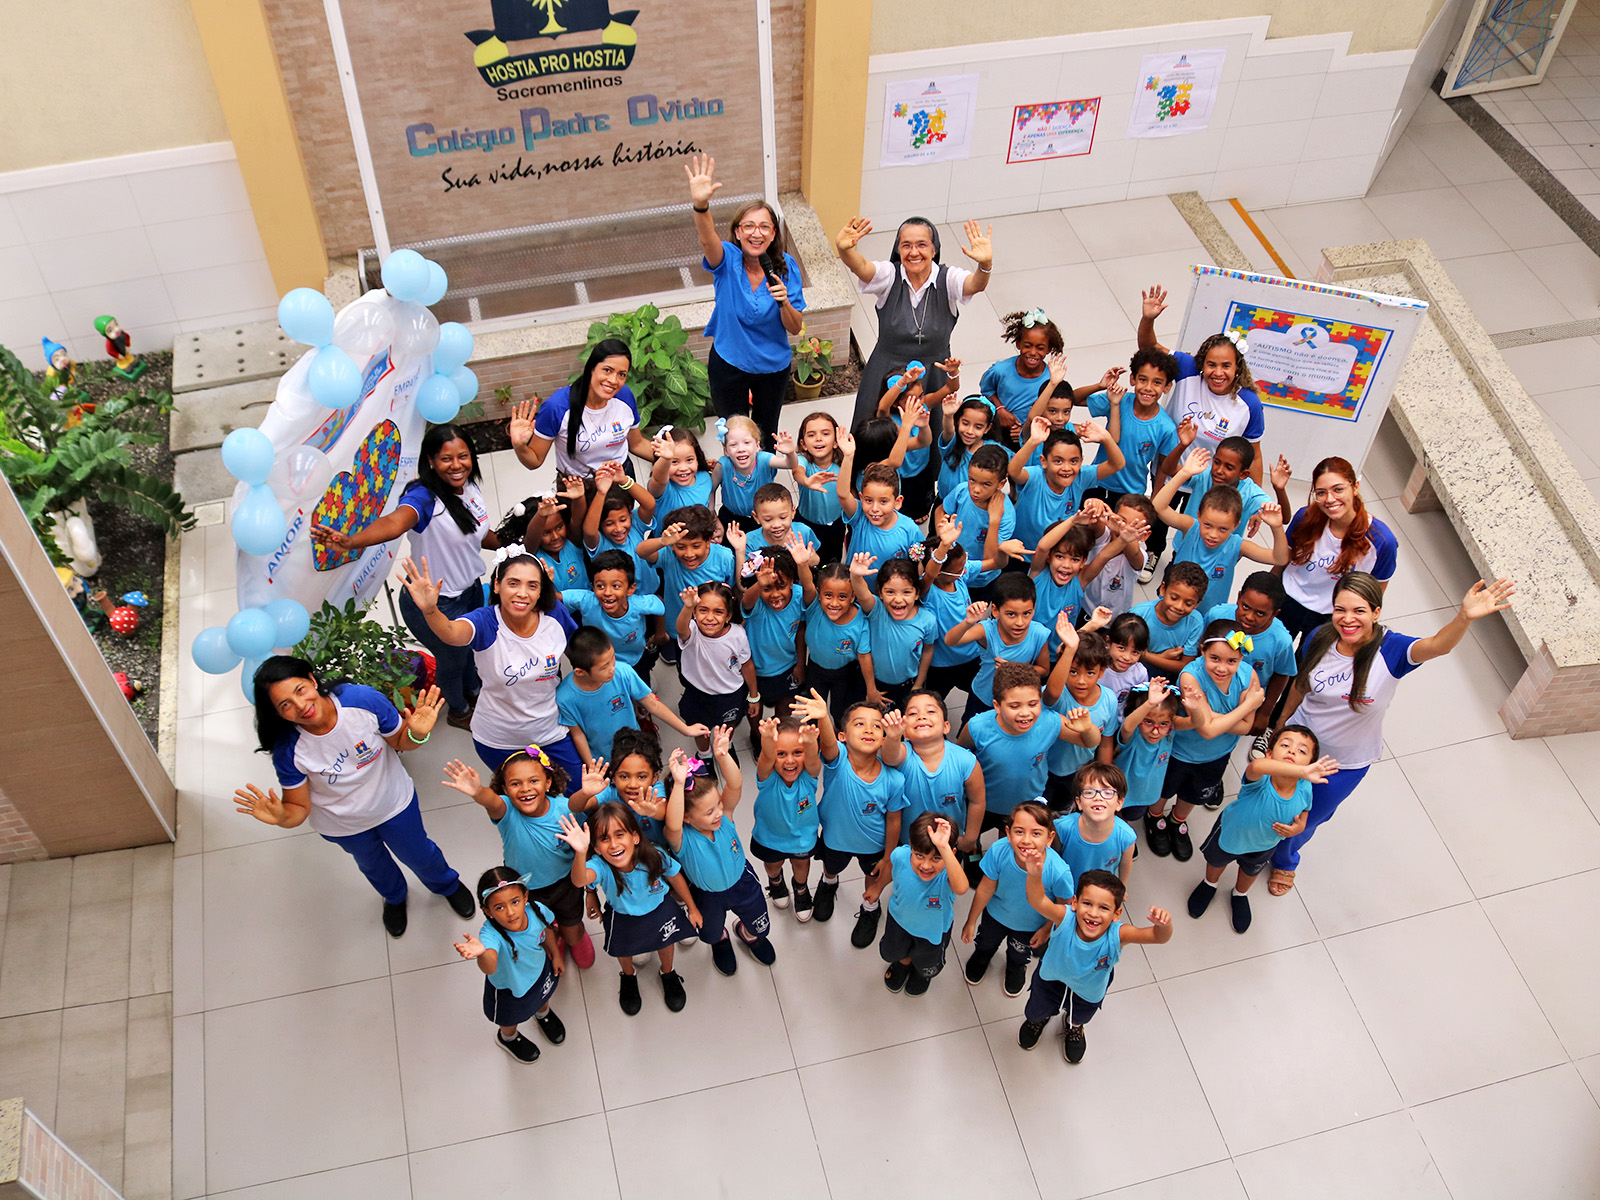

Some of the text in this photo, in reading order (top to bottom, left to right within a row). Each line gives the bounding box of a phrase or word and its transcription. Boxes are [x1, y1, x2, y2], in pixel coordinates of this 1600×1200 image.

[486, 48, 627, 83] HOSTIA PRO HOSTIA
[496, 75, 623, 101] Sacramentinas
[520, 107, 611, 151] Padre
[441, 168, 481, 192] Sua
[1282, 368, 1300, 376] com
[577, 423, 607, 453] Sou
[268, 516, 303, 575] AMOR
[503, 657, 539, 687] Sou
[1313, 670, 1352, 693] Sou
[320, 748, 349, 785] Sou
